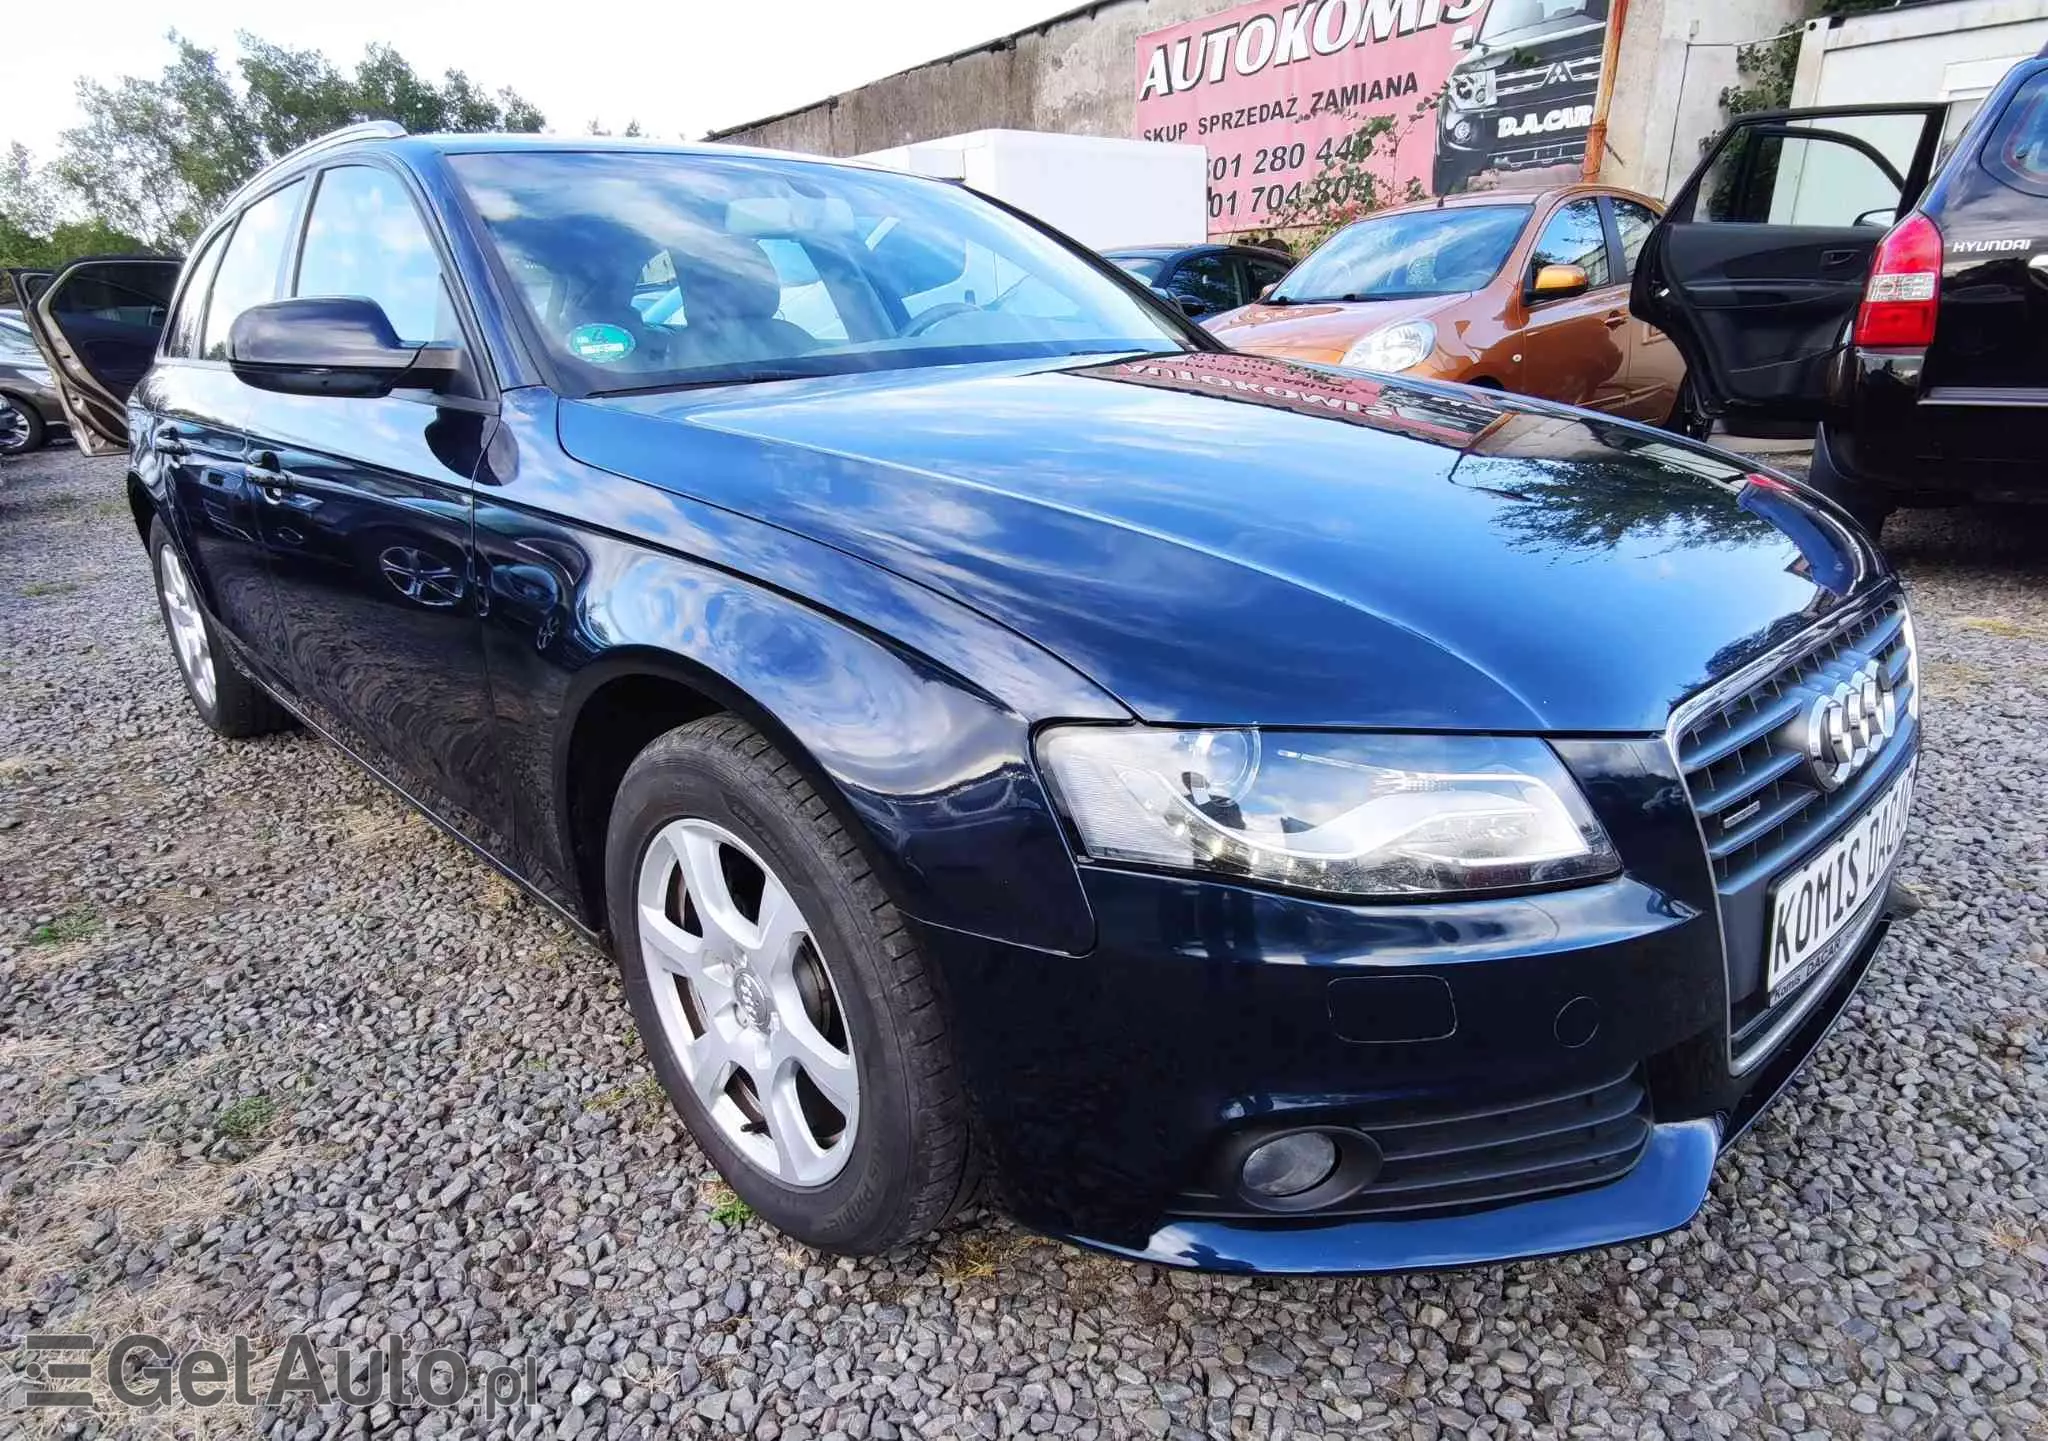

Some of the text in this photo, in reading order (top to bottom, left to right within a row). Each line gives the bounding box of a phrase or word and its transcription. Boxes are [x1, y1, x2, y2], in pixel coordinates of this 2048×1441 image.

[1143, 71, 1419, 142] SKUP SPRZEDAŻ ZAMIANA
[1207, 153, 1242, 181] 01
[1253, 142, 1306, 174] 280
[1207, 186, 1238, 218] 01
[1251, 181, 1302, 213] 704
[1952, 239, 2032, 253] HYUNDAI
[1773, 837, 1860, 973] KOMIS
